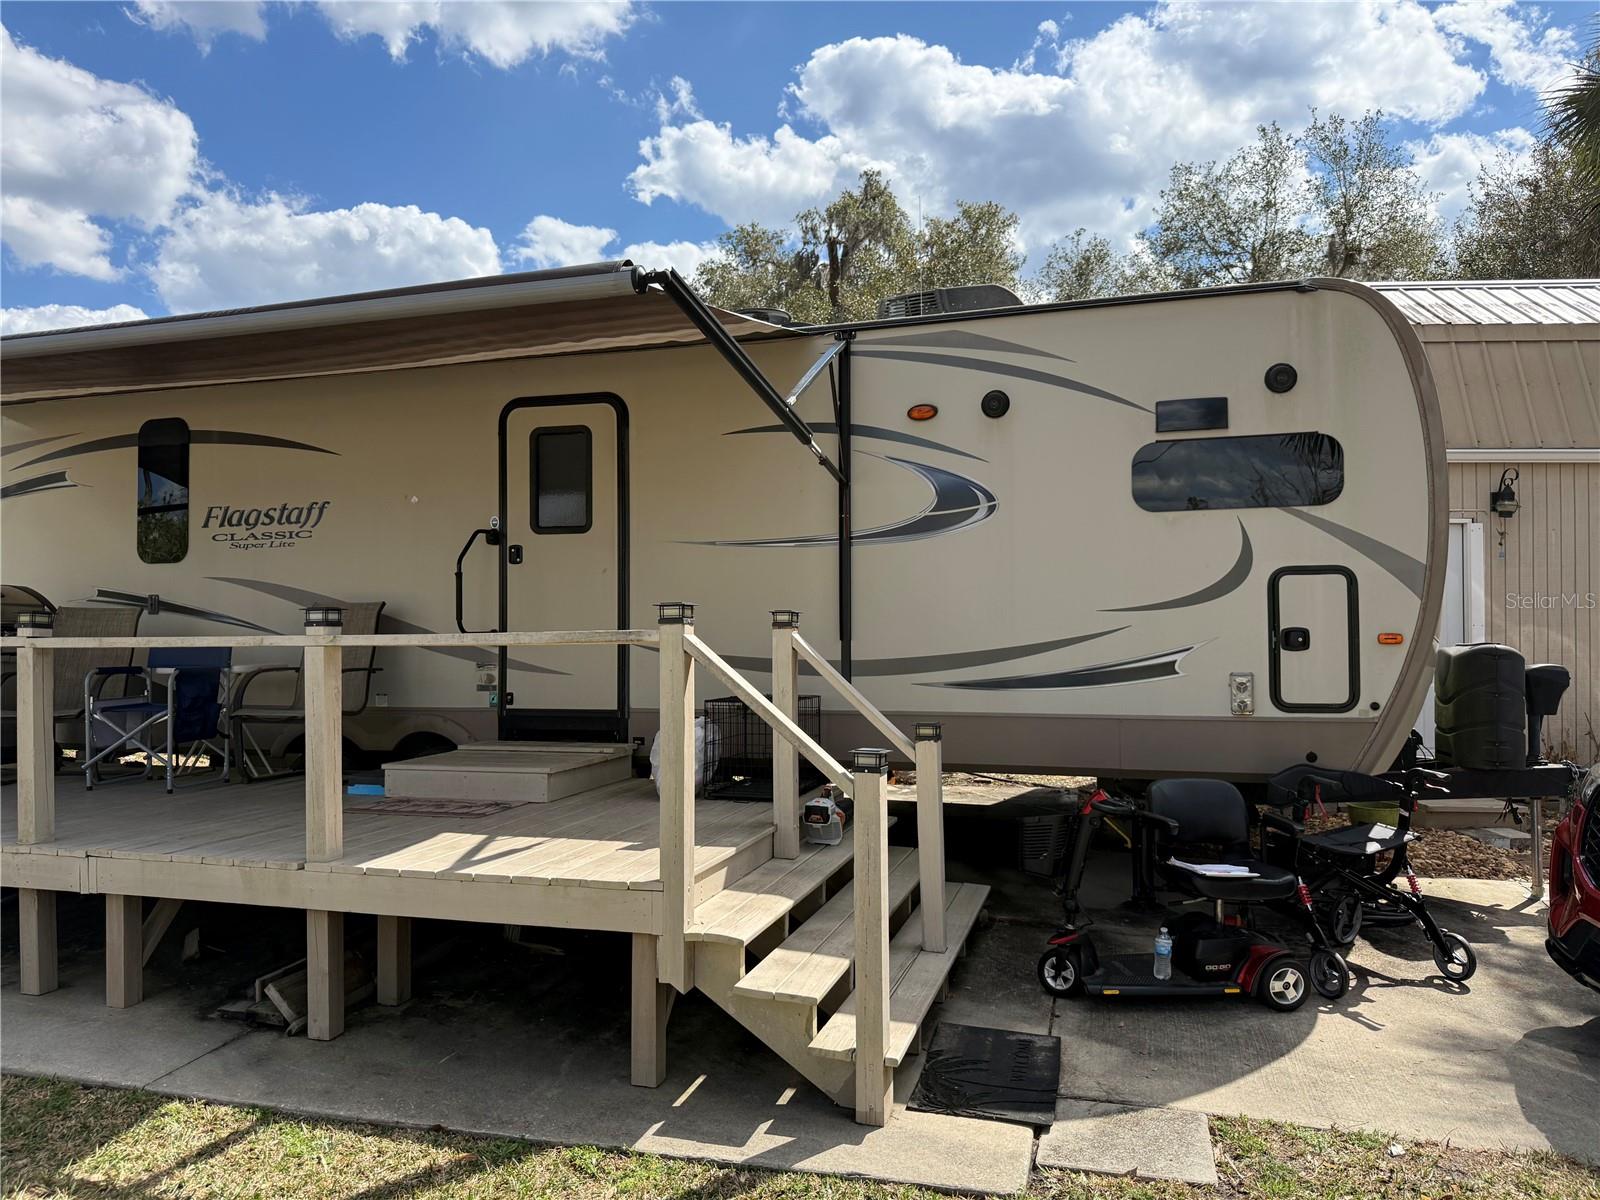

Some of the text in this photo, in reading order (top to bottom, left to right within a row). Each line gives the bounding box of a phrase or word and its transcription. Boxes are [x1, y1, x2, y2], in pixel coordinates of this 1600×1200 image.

[201, 501, 331, 531] Flagstaff
[211, 530, 313, 542] CLASSIC
[229, 540, 295, 551] Super Lite
